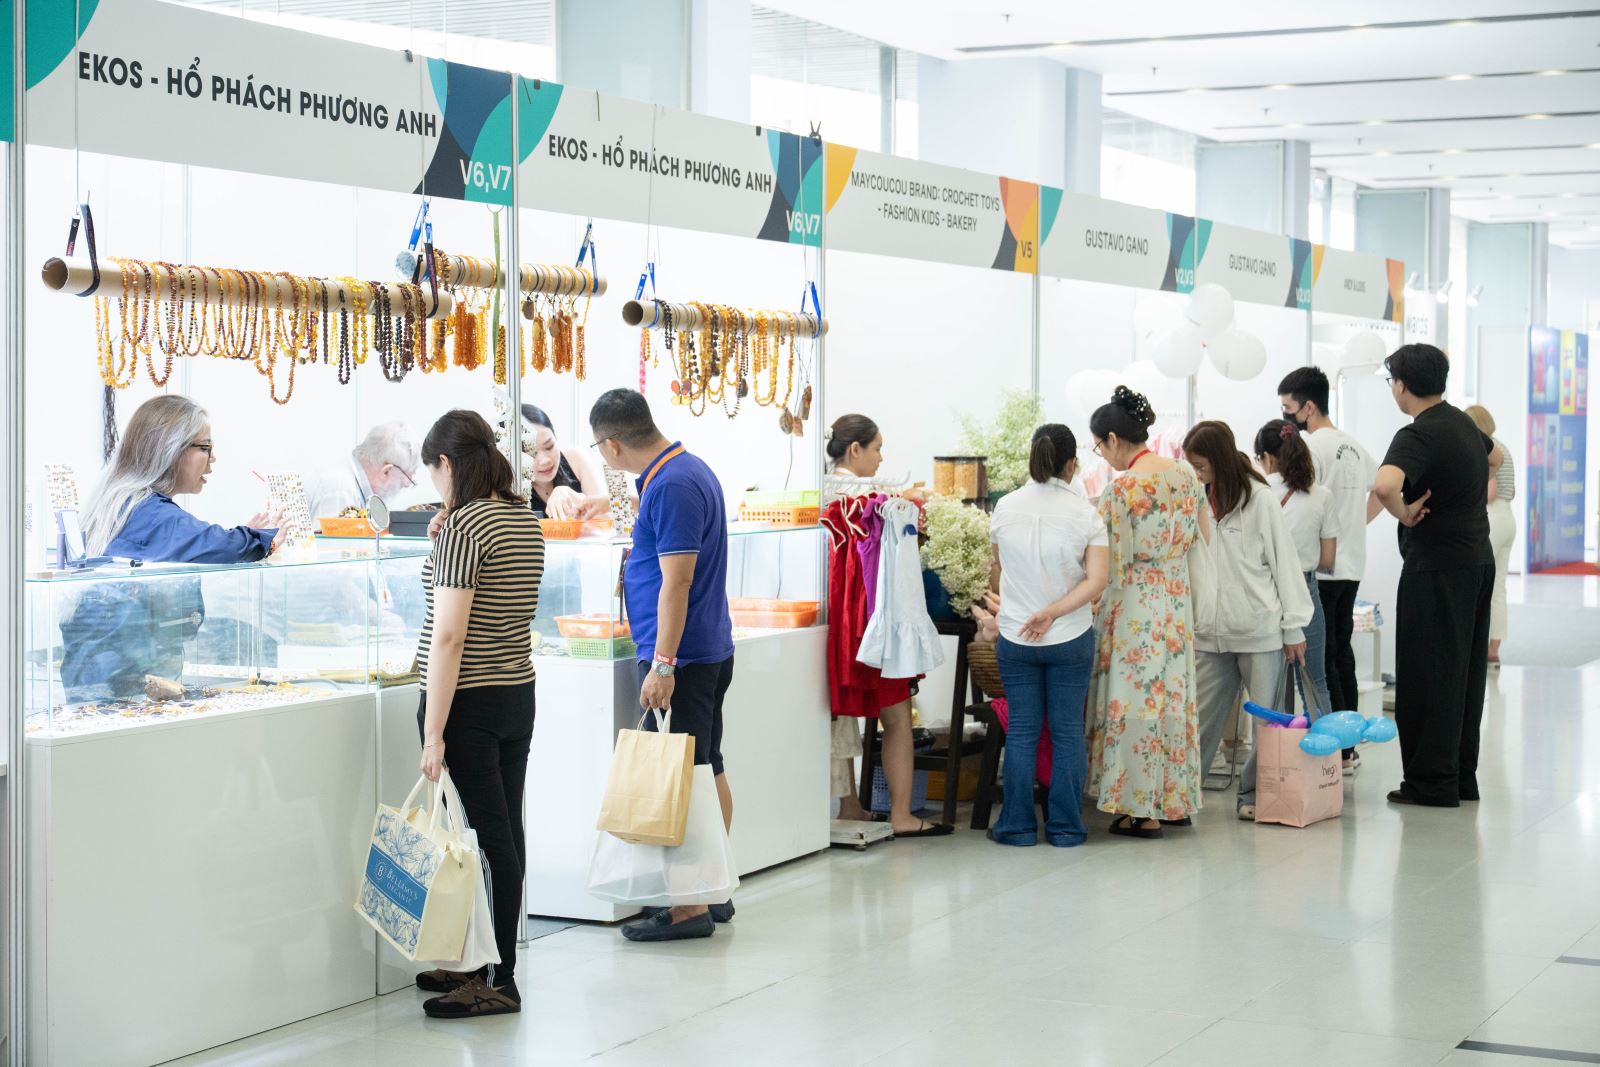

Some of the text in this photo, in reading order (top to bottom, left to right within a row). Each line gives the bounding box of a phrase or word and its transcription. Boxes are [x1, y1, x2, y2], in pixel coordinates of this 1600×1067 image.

[79, 51, 437, 137] EKOS - HỔ PHÁCH PHƯƠNG ANH
[459, 158, 512, 193] V6,V7
[548, 134, 588, 162] EKOS
[602, 135, 625, 168] HỔ
[629, 147, 680, 178] PHÁCH
[684, 159, 741, 188] PHƯƠNG
[745, 170, 772, 193] ANH
[851, 170, 1000, 212] MAYCOUCOU BRAND: CROCHET TOYS
[786, 209, 821, 237] V6,V7
[883, 203, 920, 223] FASHION
[921, 208, 940, 226] KIDS
[946, 213, 978, 232] BAKERY
[1020, 240, 1033, 258] V5
[1085, 229, 1149, 257] GUSTAVO GANO
[1229, 253, 1277, 278] GUSTAVO GANO
